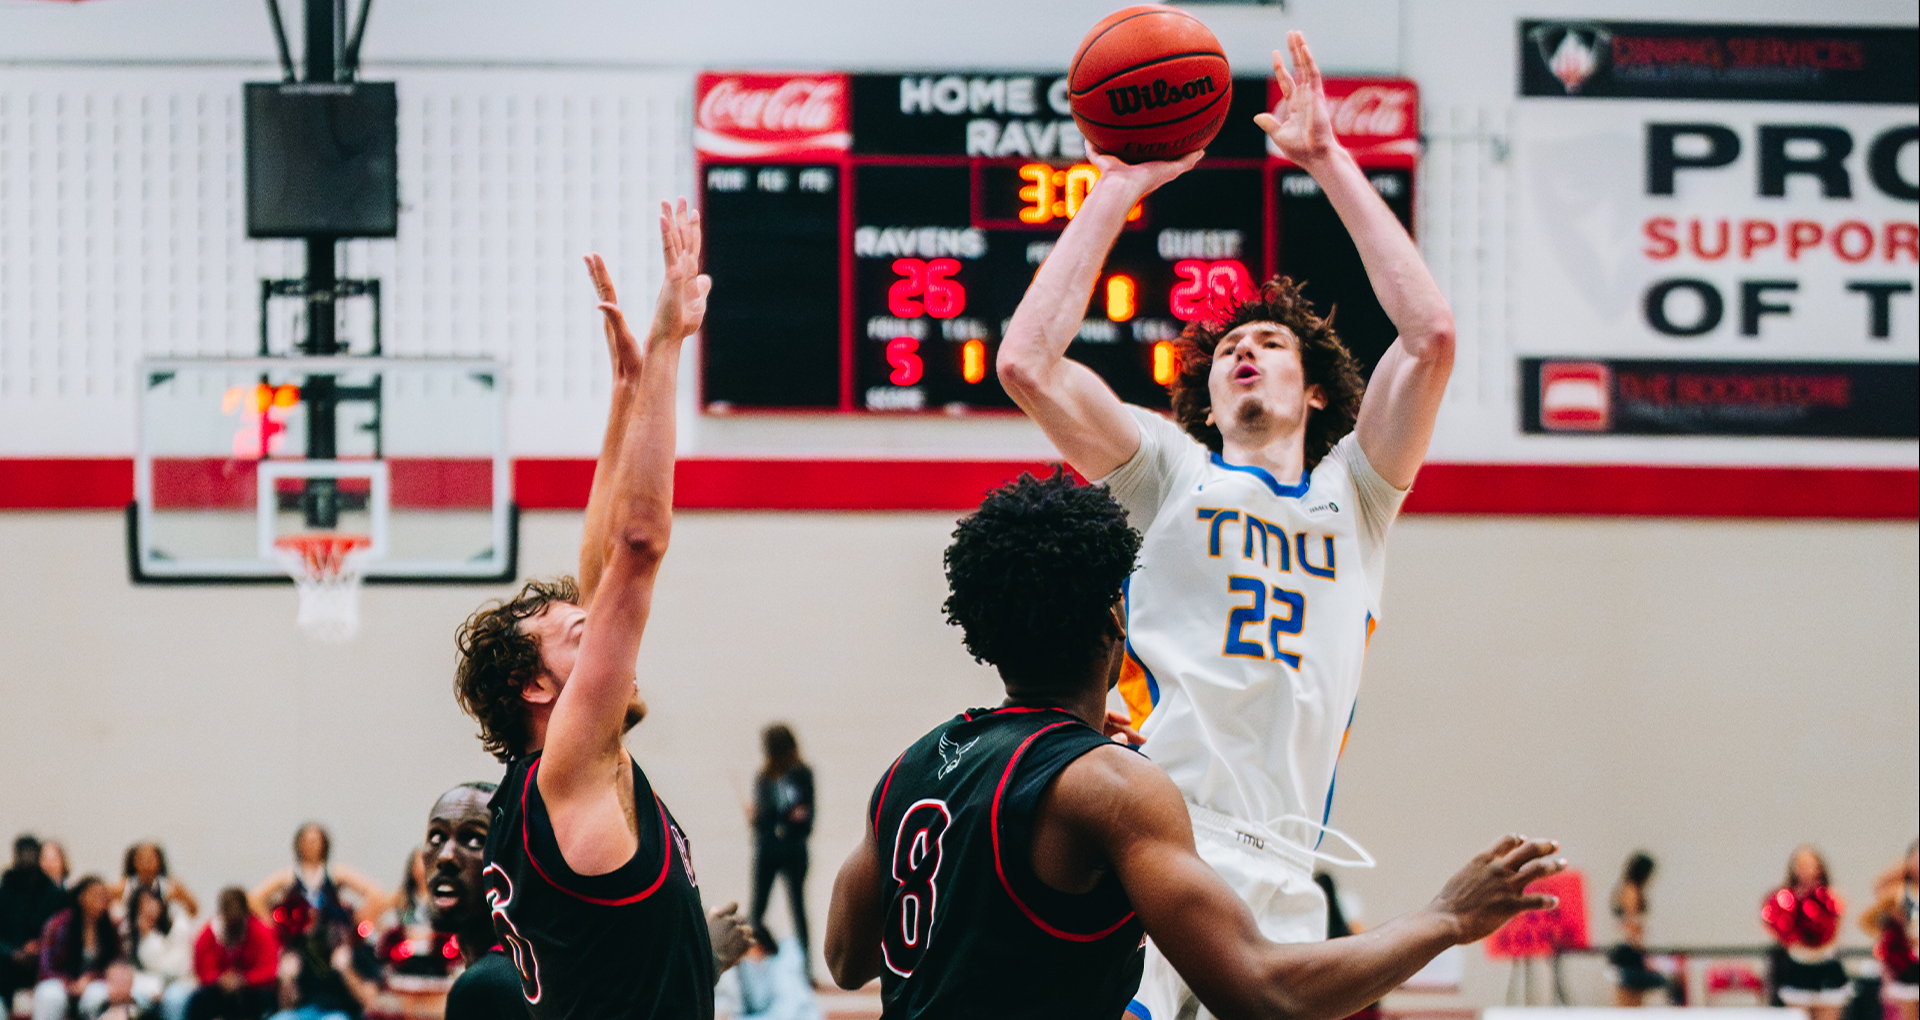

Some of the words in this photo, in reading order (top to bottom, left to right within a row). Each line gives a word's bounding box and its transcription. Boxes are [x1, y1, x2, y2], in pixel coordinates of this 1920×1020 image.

[900, 76, 1035, 116] HOME
[1105, 75, 1216, 117] Wilson
[966, 119, 1087, 158] RAVE
[1018, 163, 1142, 223] 3:0
[855, 228, 986, 258] RAVENS
[1158, 229, 1242, 259] GUEST
[888, 258, 966, 319] 26
[1644, 278, 1798, 338] OF
[1846, 281, 1913, 338] T
[886, 336, 923, 386] 5
[963, 339, 985, 384] 1
[1154, 340, 1175, 385] 1
[1196, 507, 1336, 582] TMU
[1222, 574, 1308, 672] 22
[1236, 830, 1265, 850] TMU
[881, 798, 951, 978] 8
